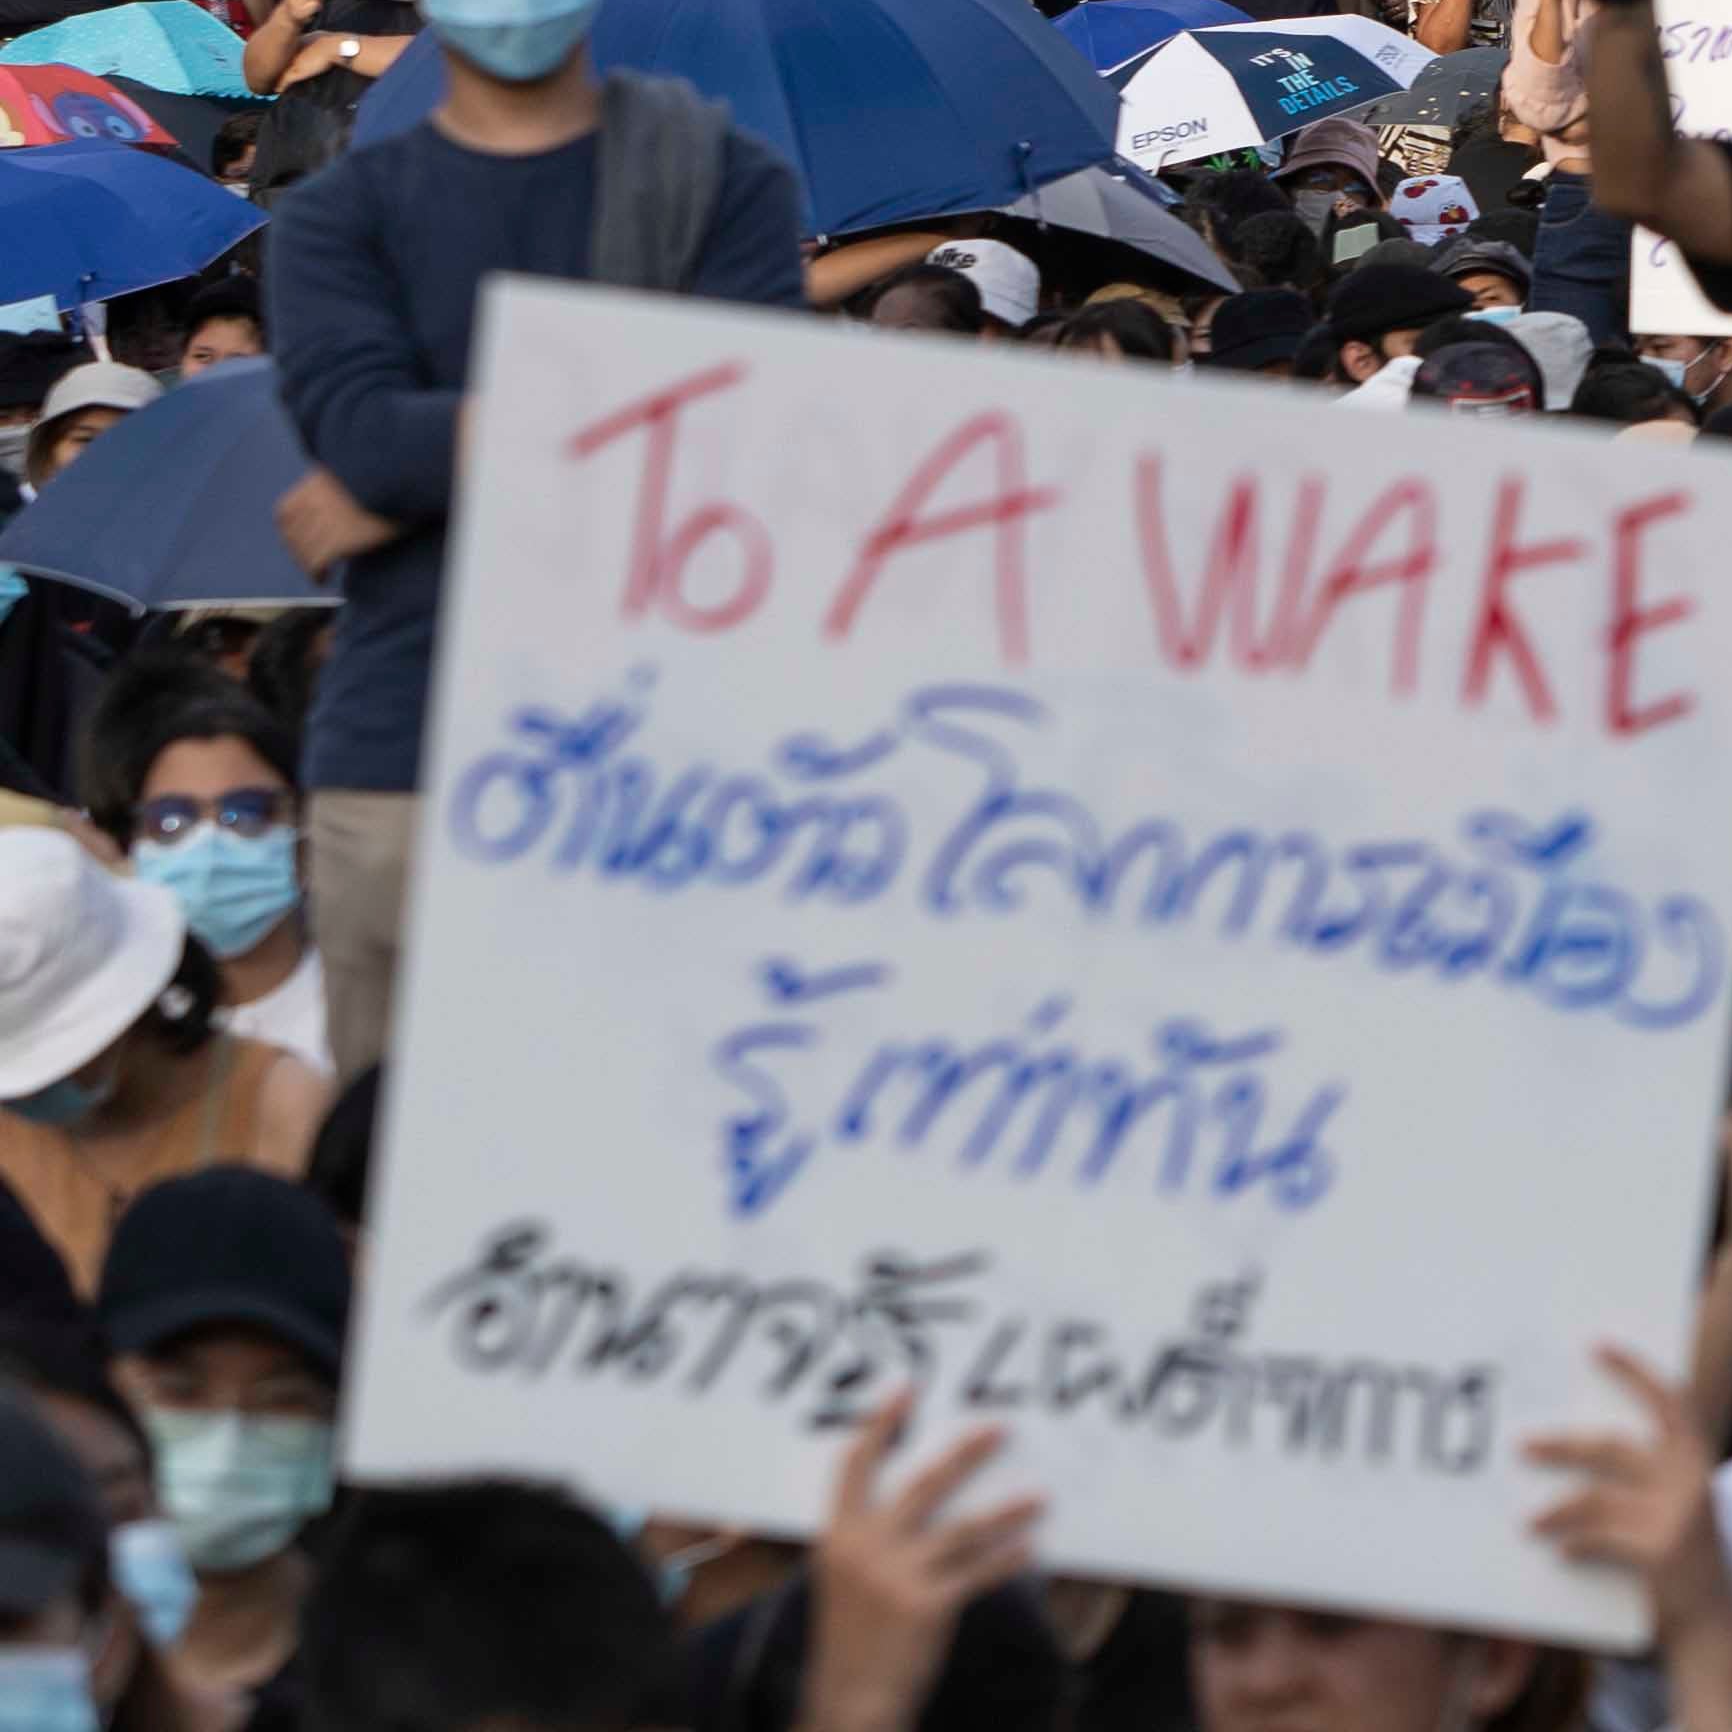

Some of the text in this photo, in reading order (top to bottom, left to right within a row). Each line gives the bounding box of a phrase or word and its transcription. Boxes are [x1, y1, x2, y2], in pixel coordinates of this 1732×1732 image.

[1249, 47, 1293, 67] IT'S
[1285, 52, 1315, 72] IN
[1276, 68, 1320, 94] THE
[1132, 117, 1209, 150] EPSON
